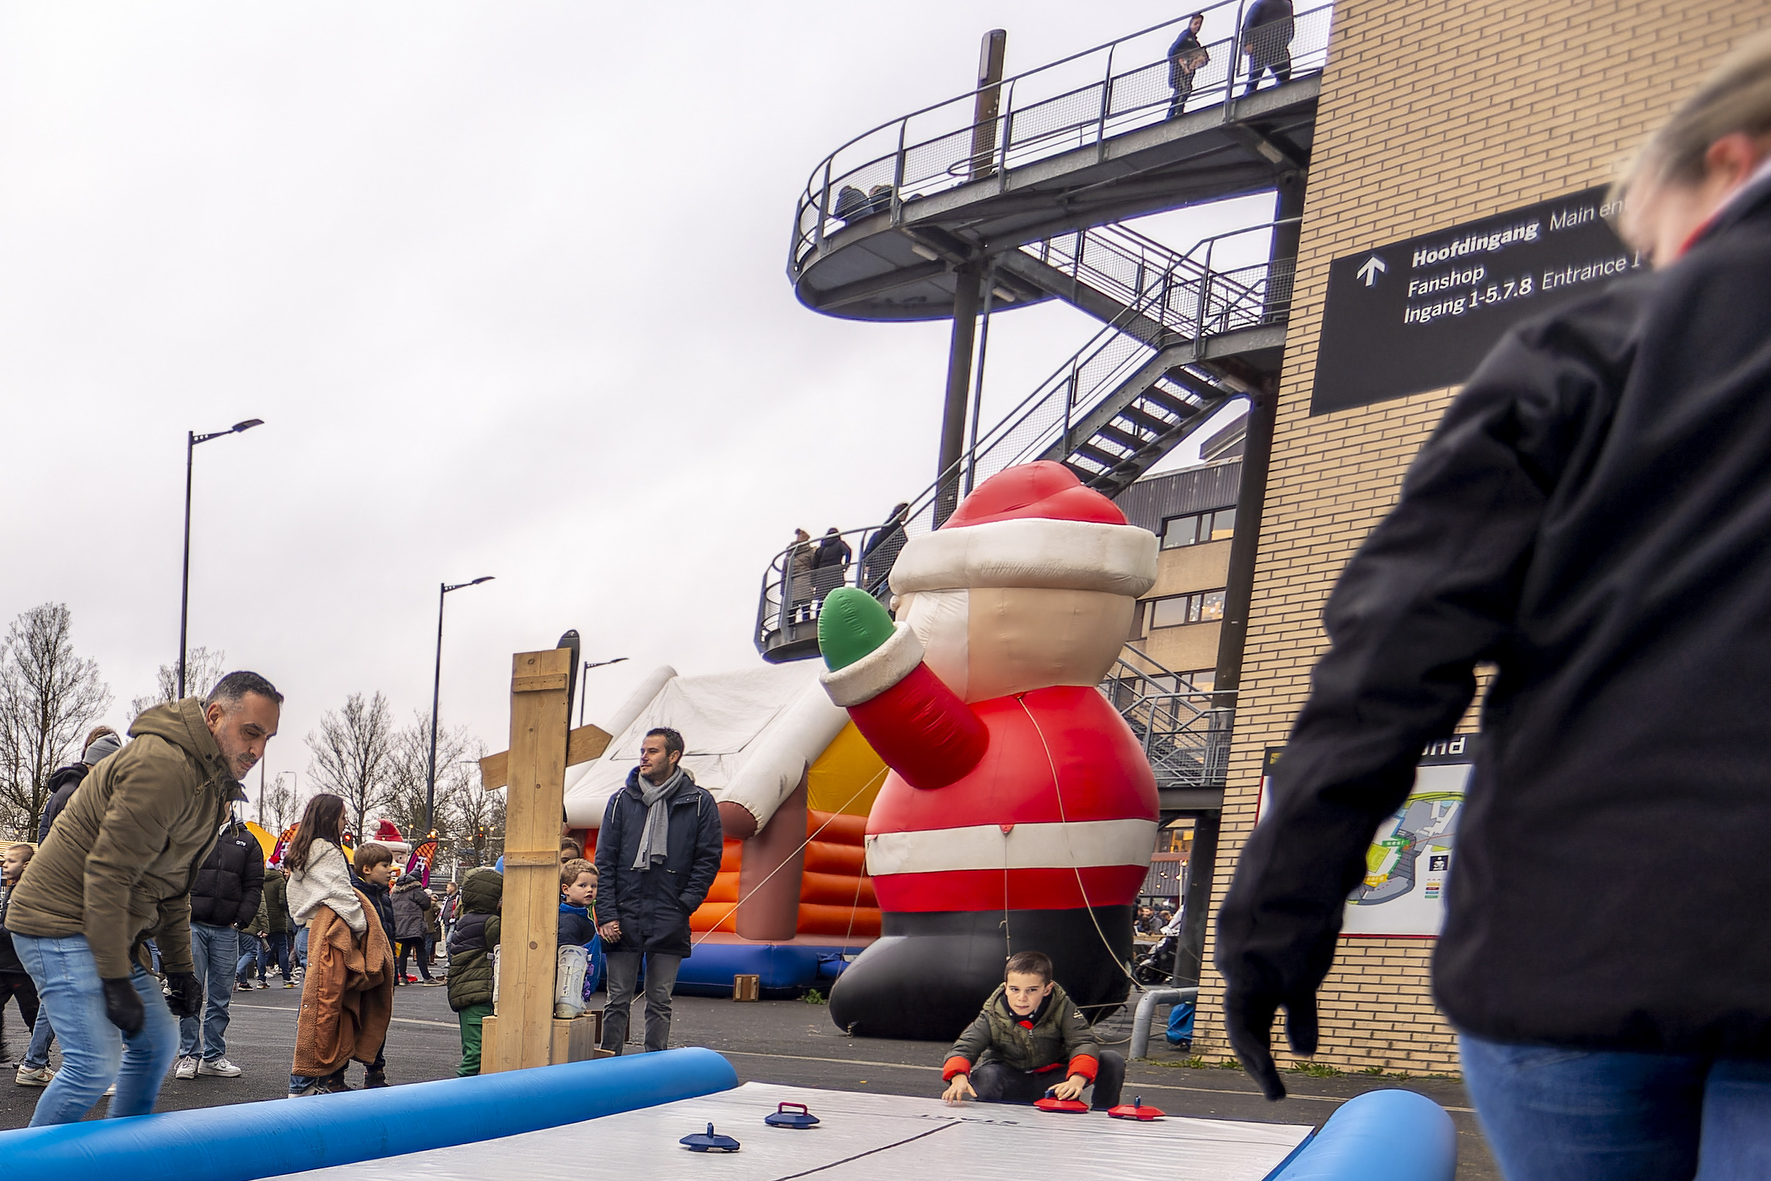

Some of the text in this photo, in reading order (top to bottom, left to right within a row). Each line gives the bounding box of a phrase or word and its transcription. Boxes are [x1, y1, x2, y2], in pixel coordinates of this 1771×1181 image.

[1549, 205, 1595, 231] Main
[1411, 222, 1540, 268] Hoofdingang
[1407, 266, 1485, 298] Fanshop
[1541, 256, 1628, 290] Entrance
[1403, 277, 1533, 324] Ingang 1-5.7.8
